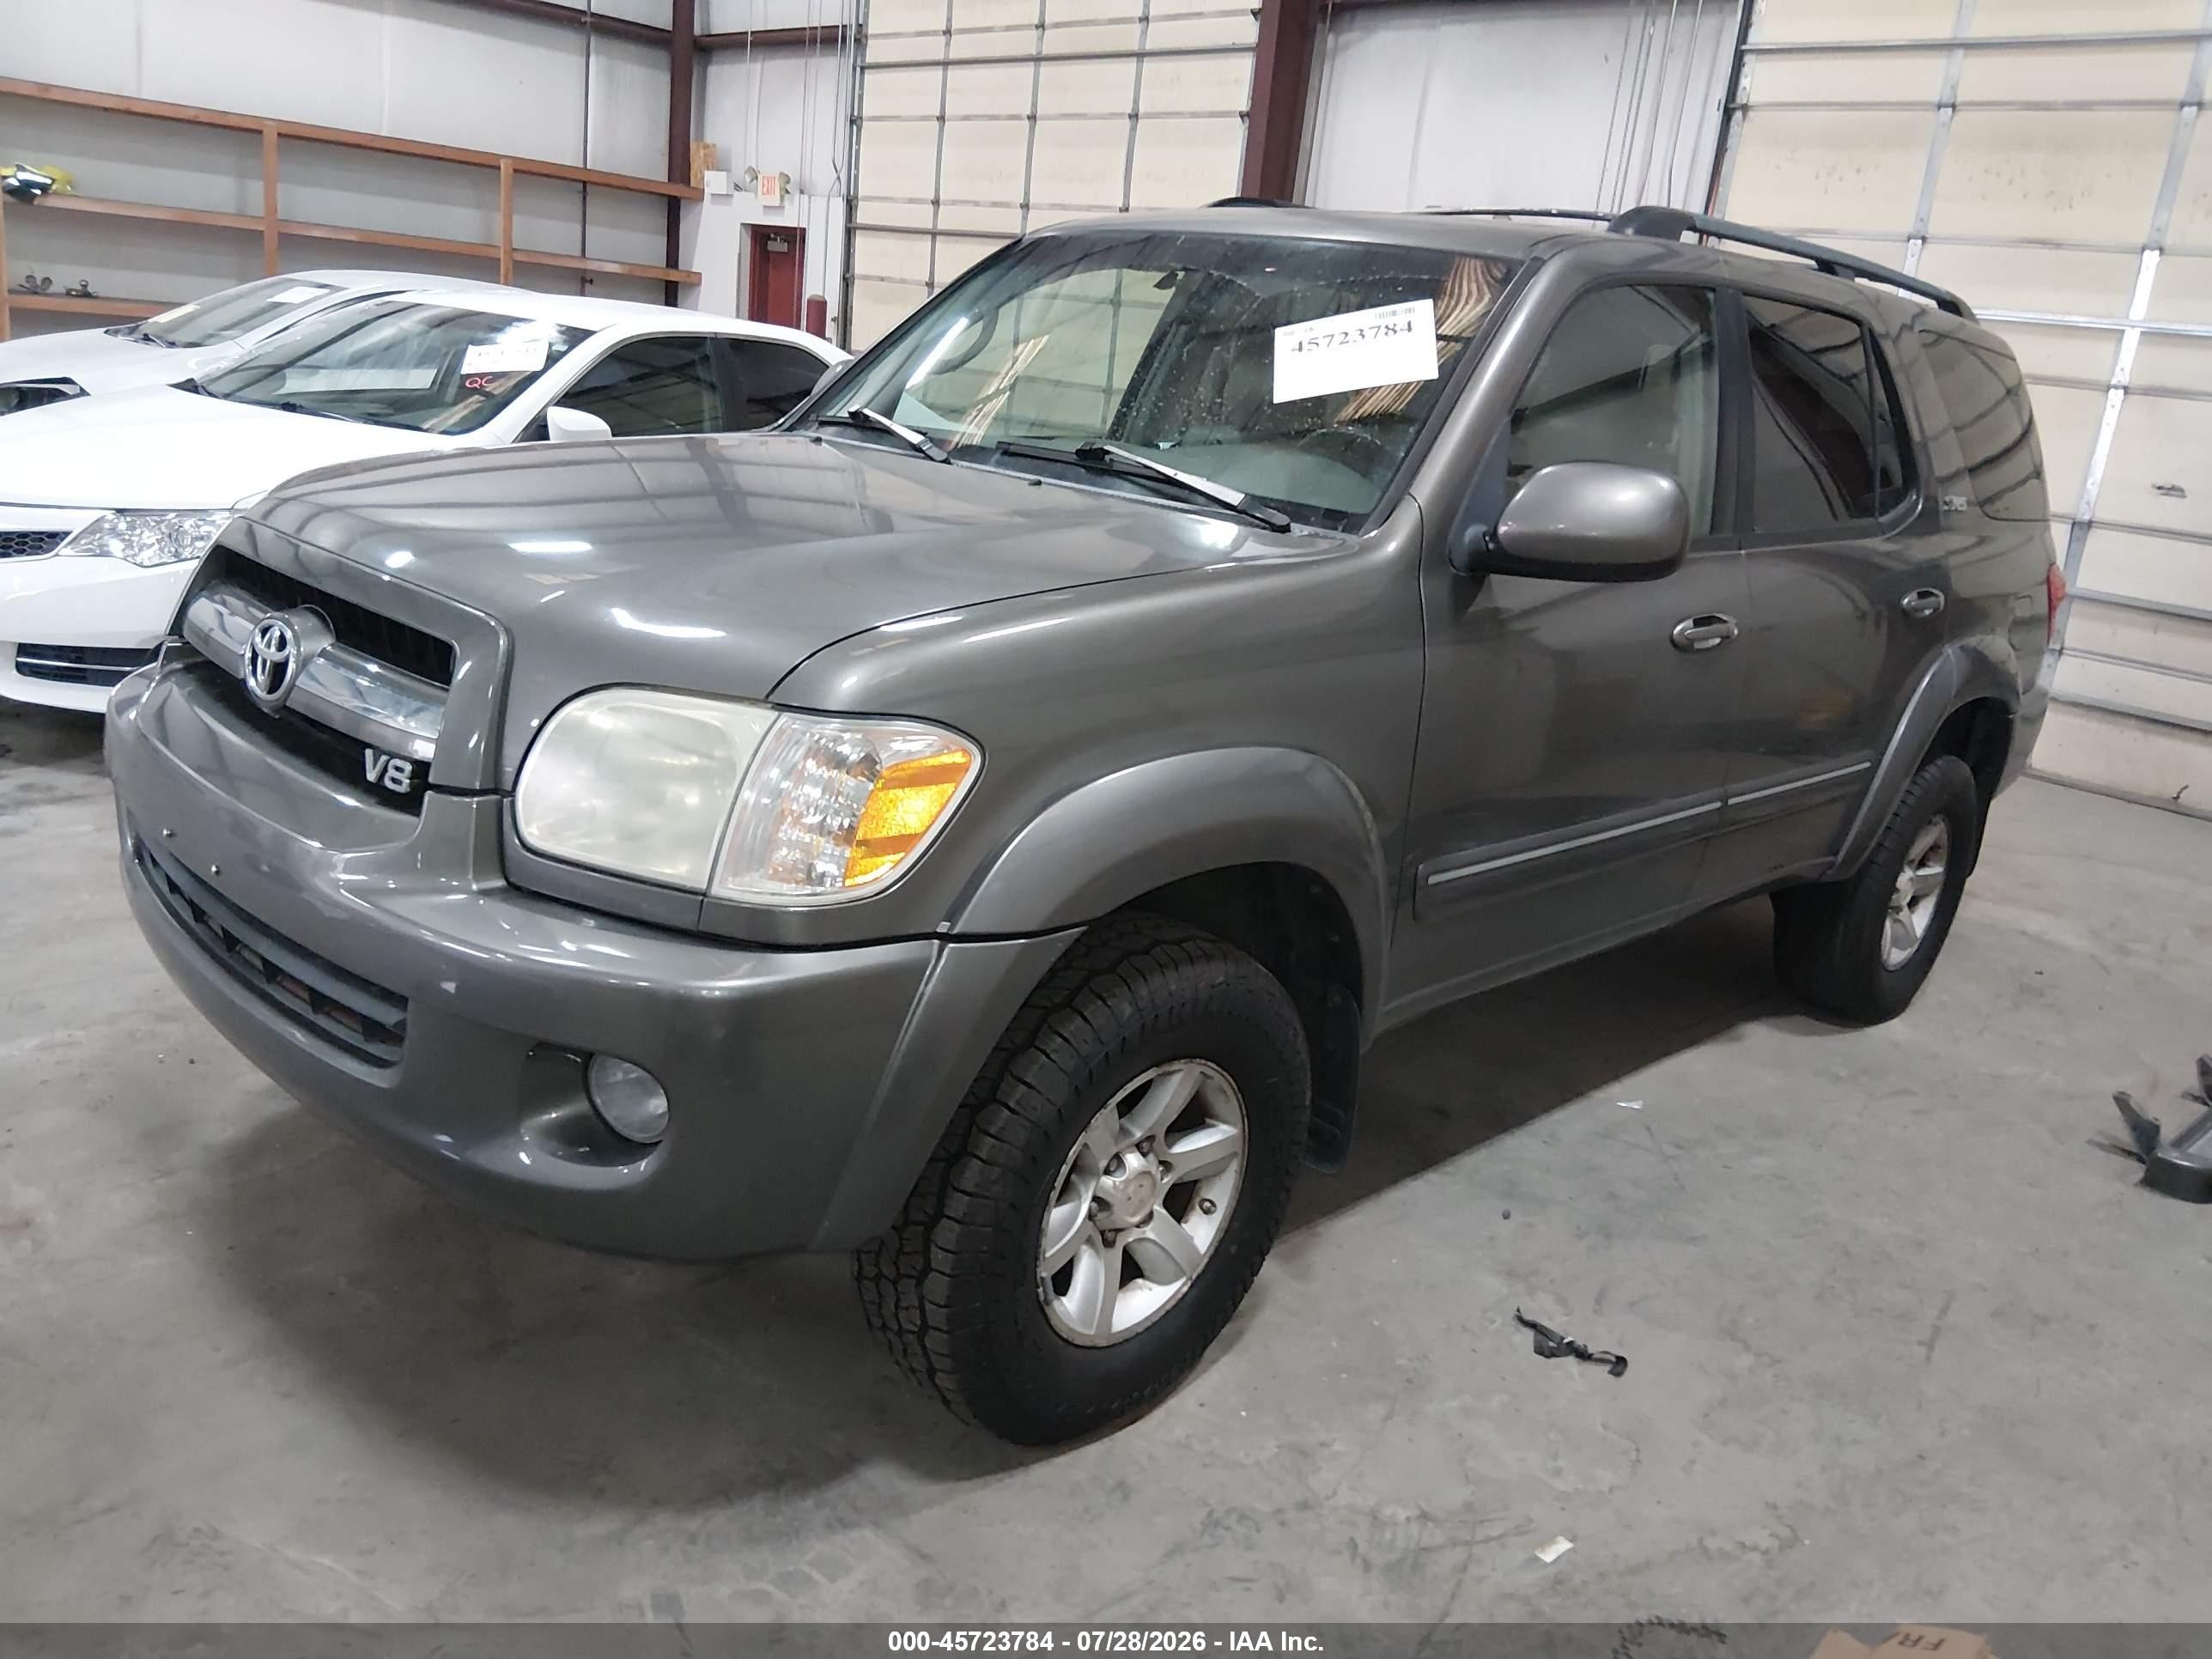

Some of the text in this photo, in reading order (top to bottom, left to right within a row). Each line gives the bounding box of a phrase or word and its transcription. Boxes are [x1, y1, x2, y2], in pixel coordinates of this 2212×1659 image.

[762, 176, 776, 195] EXIT
[1291, 319, 1413, 353] 45723784
[465, 375, 494, 389] QC
[364, 748, 413, 793] V8
